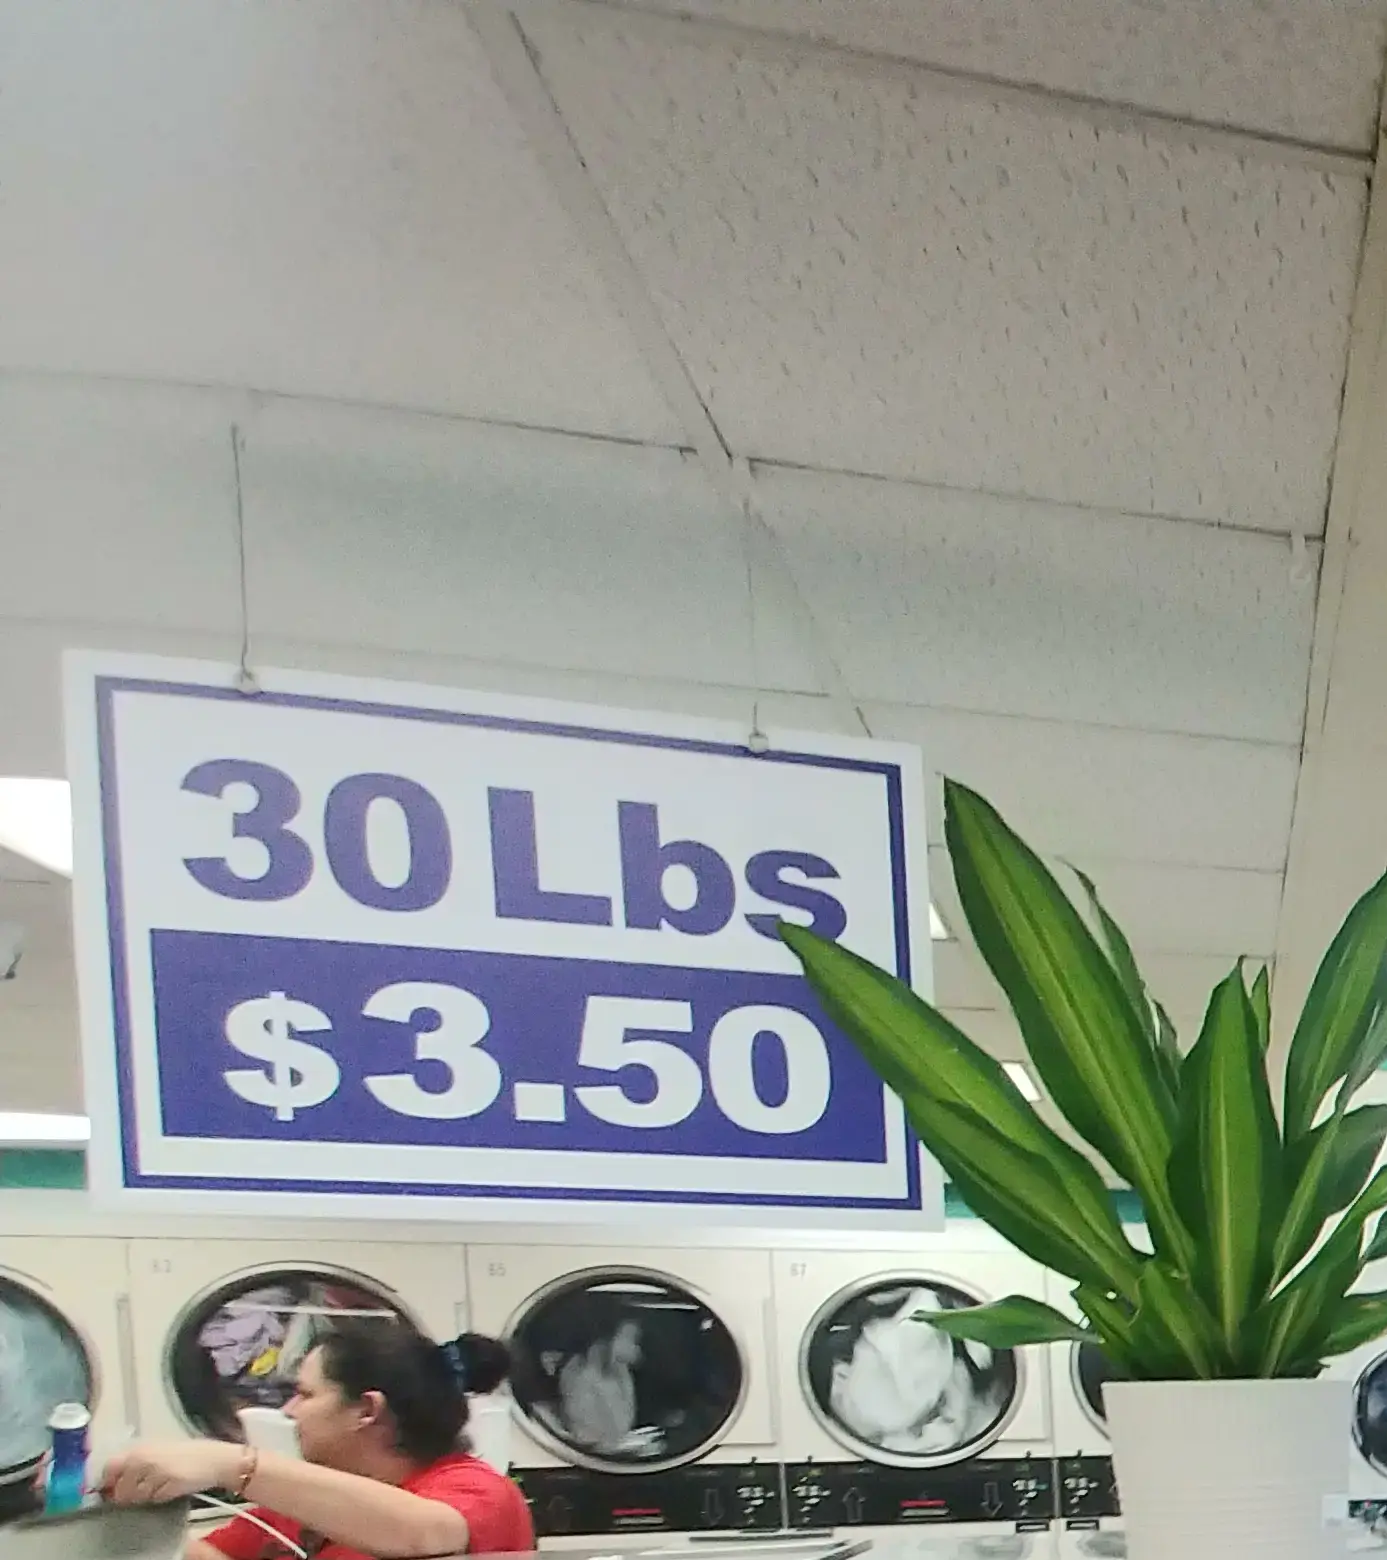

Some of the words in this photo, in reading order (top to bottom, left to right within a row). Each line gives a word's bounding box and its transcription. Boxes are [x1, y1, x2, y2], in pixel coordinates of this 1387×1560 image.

[180, 758, 453, 912] 30
[487, 786, 848, 943] Lbs
[222, 979, 832, 1136] $3.50
